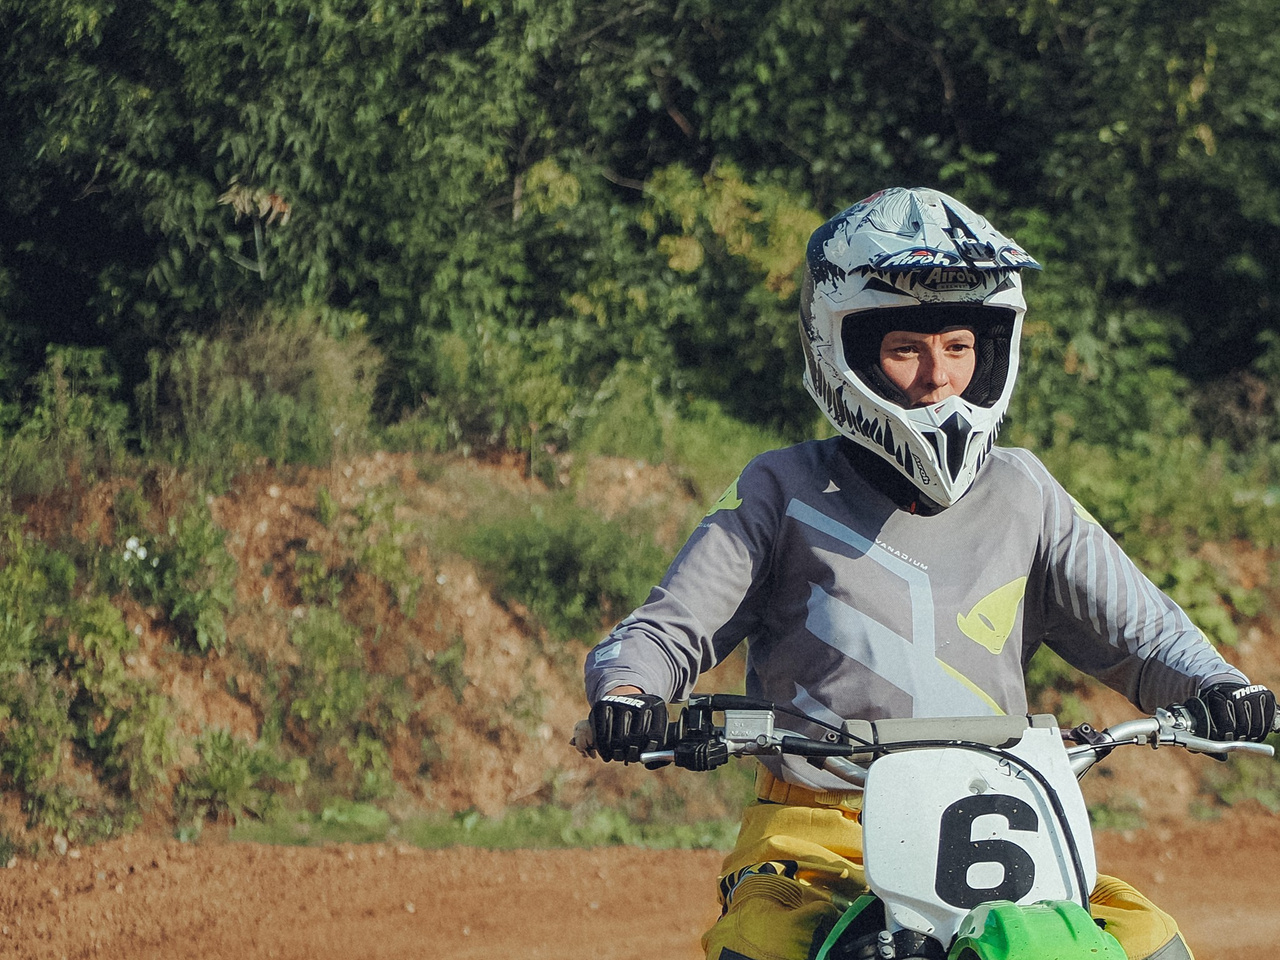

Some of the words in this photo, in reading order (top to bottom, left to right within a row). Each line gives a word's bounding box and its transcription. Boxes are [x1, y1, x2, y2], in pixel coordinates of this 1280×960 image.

[880, 250, 950, 267] Airoh
[924, 267, 977, 284] Airoh
[911, 453, 930, 485] Airoh
[875, 539, 928, 571] VANADIUM
[600, 695, 646, 708] THOR
[935, 794, 1038, 909] 6
